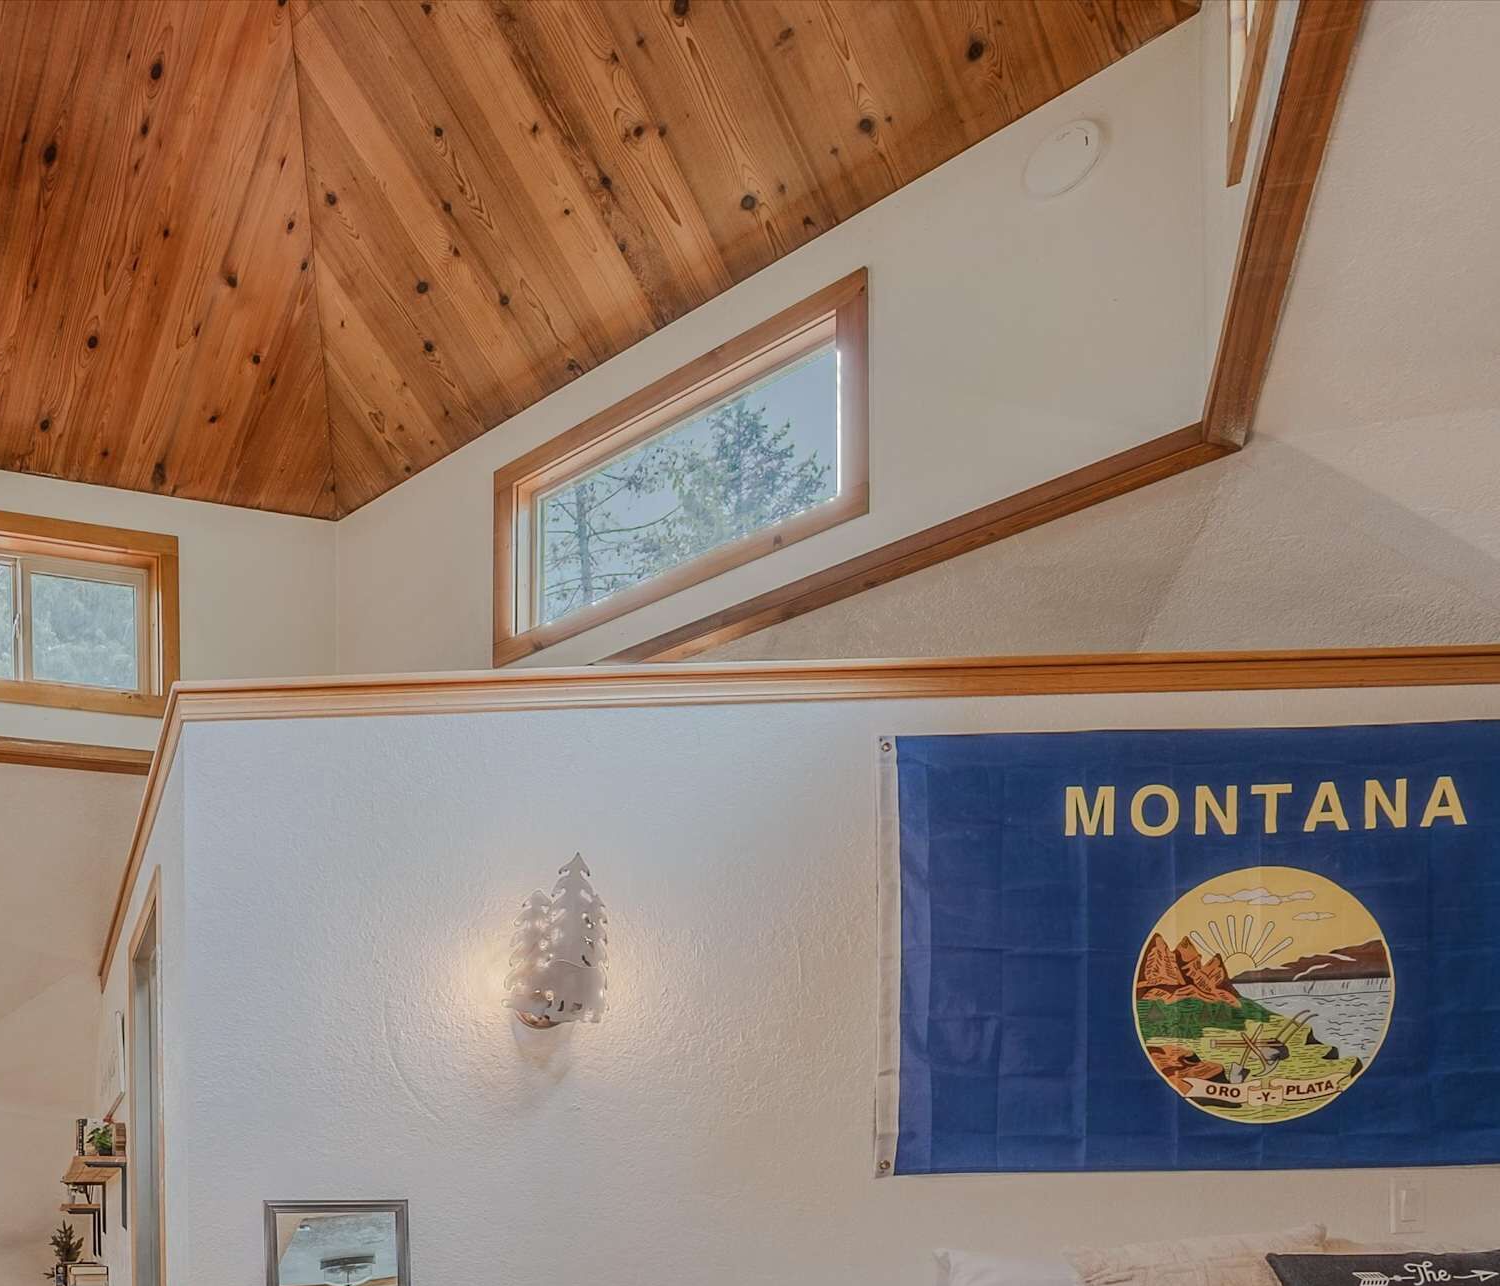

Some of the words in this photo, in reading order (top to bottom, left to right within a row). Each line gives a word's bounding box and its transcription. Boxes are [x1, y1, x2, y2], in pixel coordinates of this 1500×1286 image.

[1064, 776, 1468, 838] MONTANA
[1205, 1084, 1241, 1098] ORO
[1285, 1079, 1334, 1096] PLATA
[1404, 1260, 1451, 1286] The
